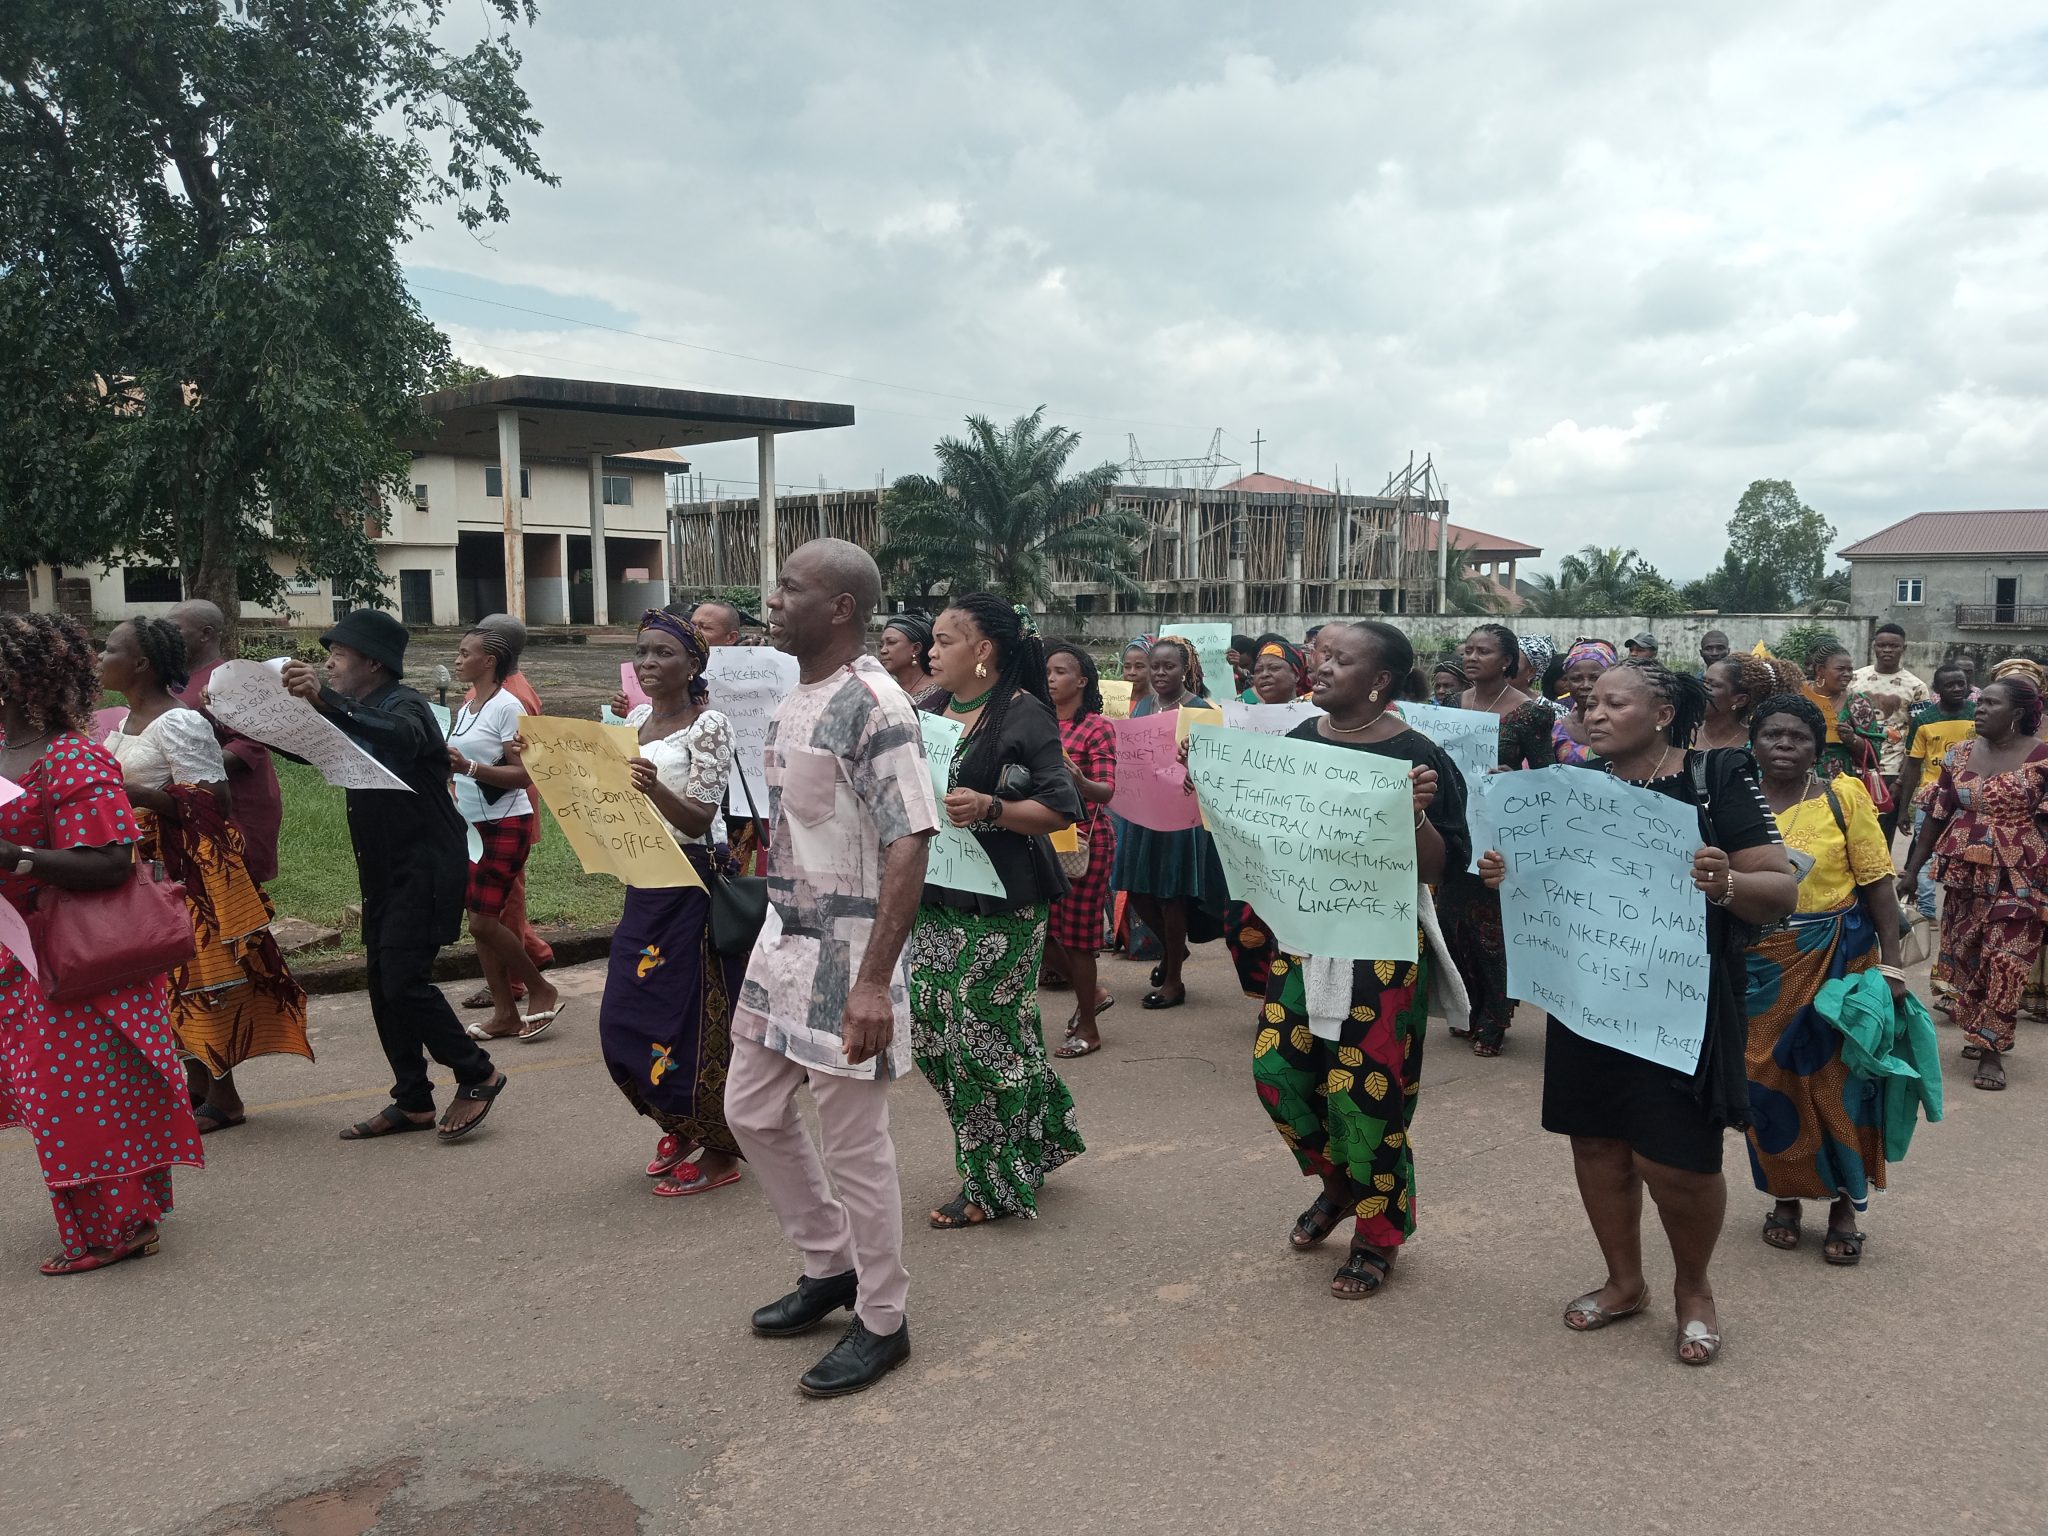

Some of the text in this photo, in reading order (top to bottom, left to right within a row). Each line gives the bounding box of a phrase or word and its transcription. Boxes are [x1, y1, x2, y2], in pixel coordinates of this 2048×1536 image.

[1410, 715, 1472, 736] PURPORTED
[1443, 739, 1497, 758] BY MR
[1200, 738, 1232, 763] THE
[1302, 760, 1318, 775] IN
[1324, 766, 1362, 786] OUR
[1369, 770, 1409, 791] TOWN
[1193, 769, 1224, 792] ARE
[1294, 794, 1316, 814] TO
[1319, 800, 1389, 828] CHANGE
[557, 802, 582, 819] OF
[635, 811, 651, 827] IS
[1503, 790, 1557, 814] OUR
[1565, 787, 1622, 817] ABLE
[1633, 805, 1686, 840] GOV.
[1498, 813, 1554, 846] PROF.
[1566, 816, 1595, 835] C
[1601, 823, 1628, 840] C
[1266, 835, 1294, 857] TO
[1514, 846, 1600, 874] PLEASE
[1609, 856, 1657, 881] SET
[1329, 877, 1379, 893] OWN
[1509, 878, 1706, 942] A PANEL TO WADE
[1522, 910, 1562, 927] INTO
